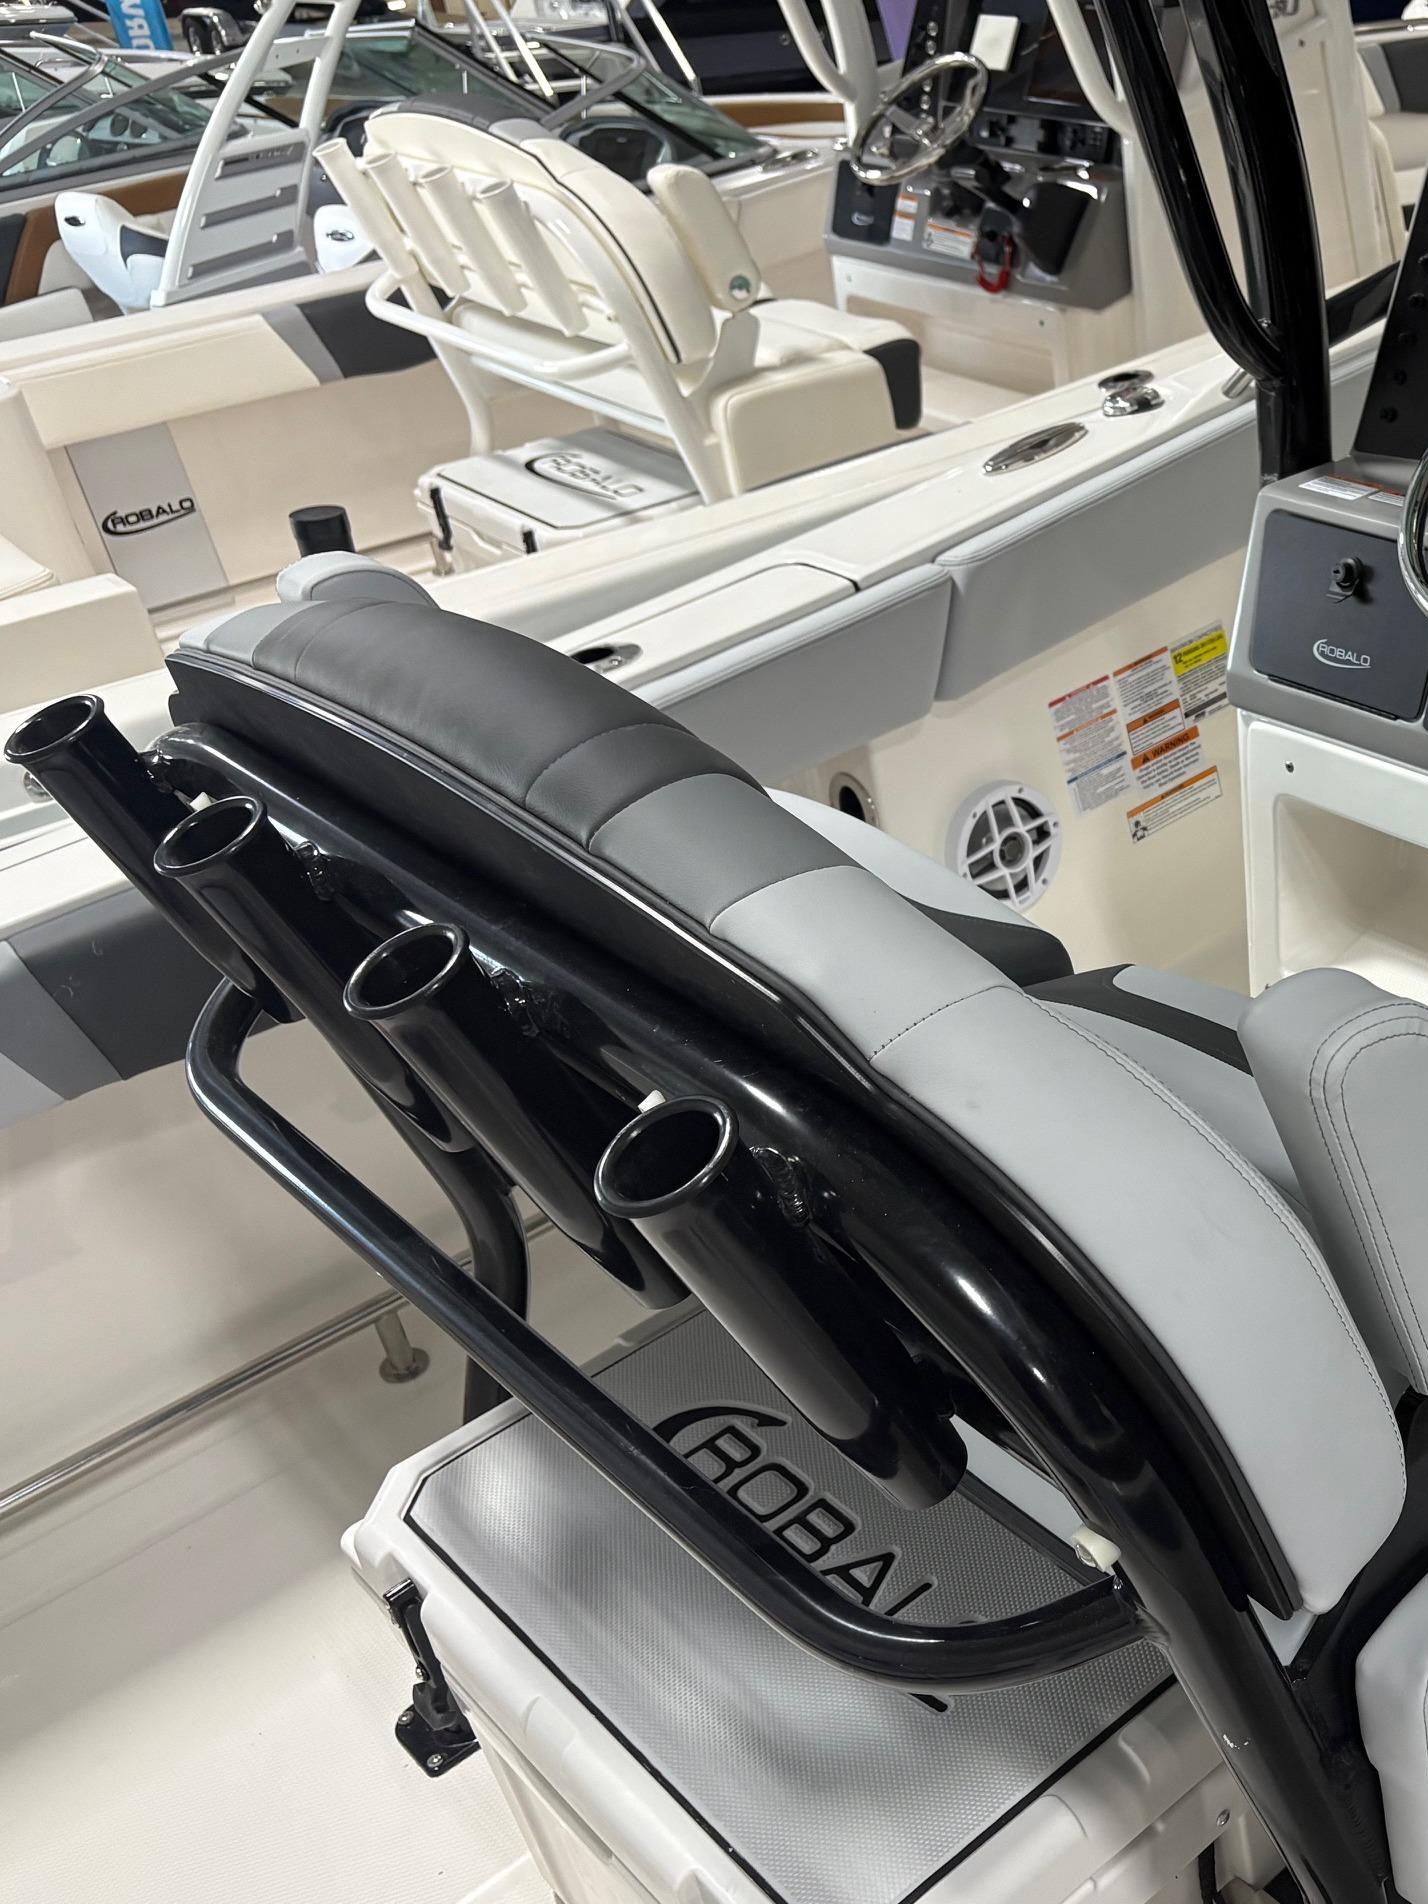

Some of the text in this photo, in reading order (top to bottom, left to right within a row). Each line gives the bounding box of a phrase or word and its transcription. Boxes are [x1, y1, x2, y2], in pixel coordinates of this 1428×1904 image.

[107, 497, 195, 531] ROBALO
[1317, 643, 1371, 667] ROBALO
[1151, 732, 1190, 758] WARNING
